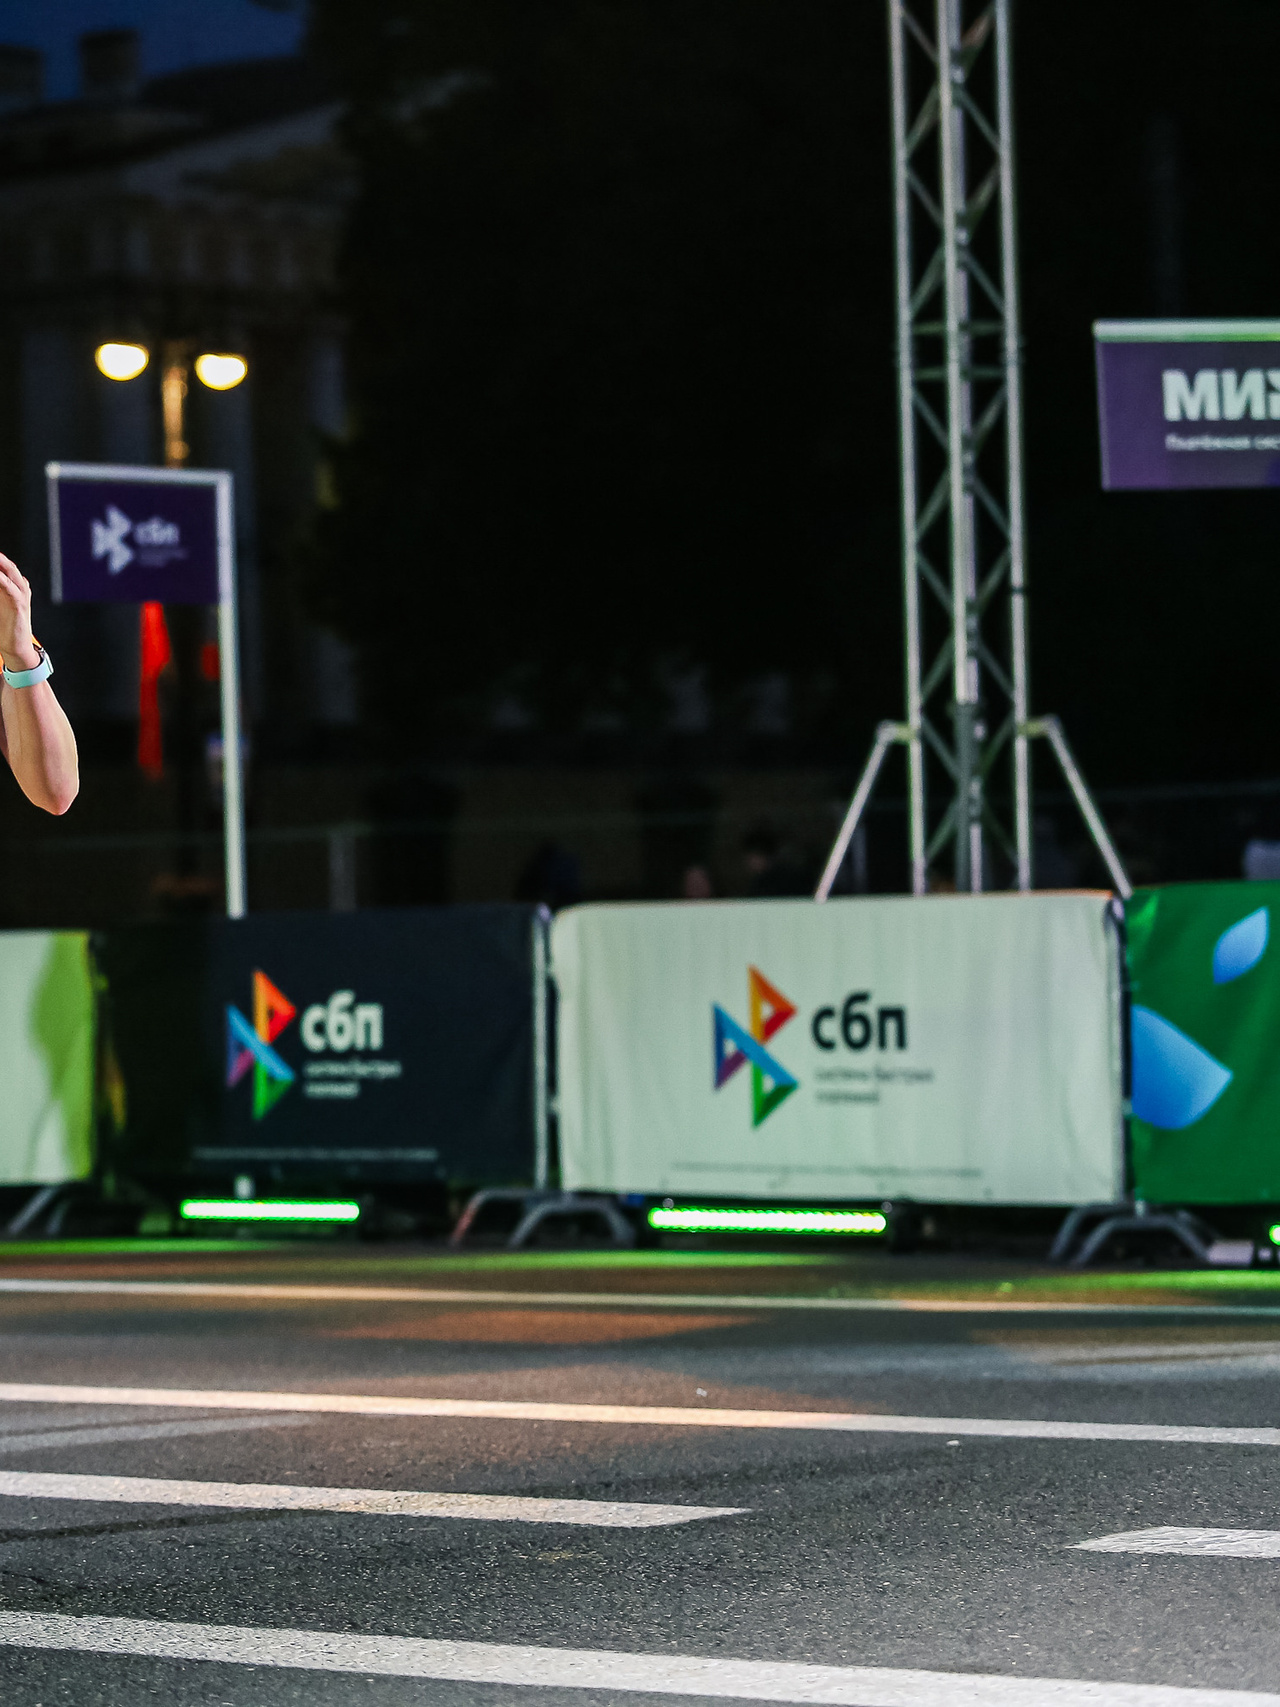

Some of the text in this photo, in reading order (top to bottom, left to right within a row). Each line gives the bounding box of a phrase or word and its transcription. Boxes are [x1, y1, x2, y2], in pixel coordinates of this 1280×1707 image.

[1162, 368, 1280, 421] МИ
[299, 988, 385, 1053] сбп
[810, 989, 908, 1052] сбп
